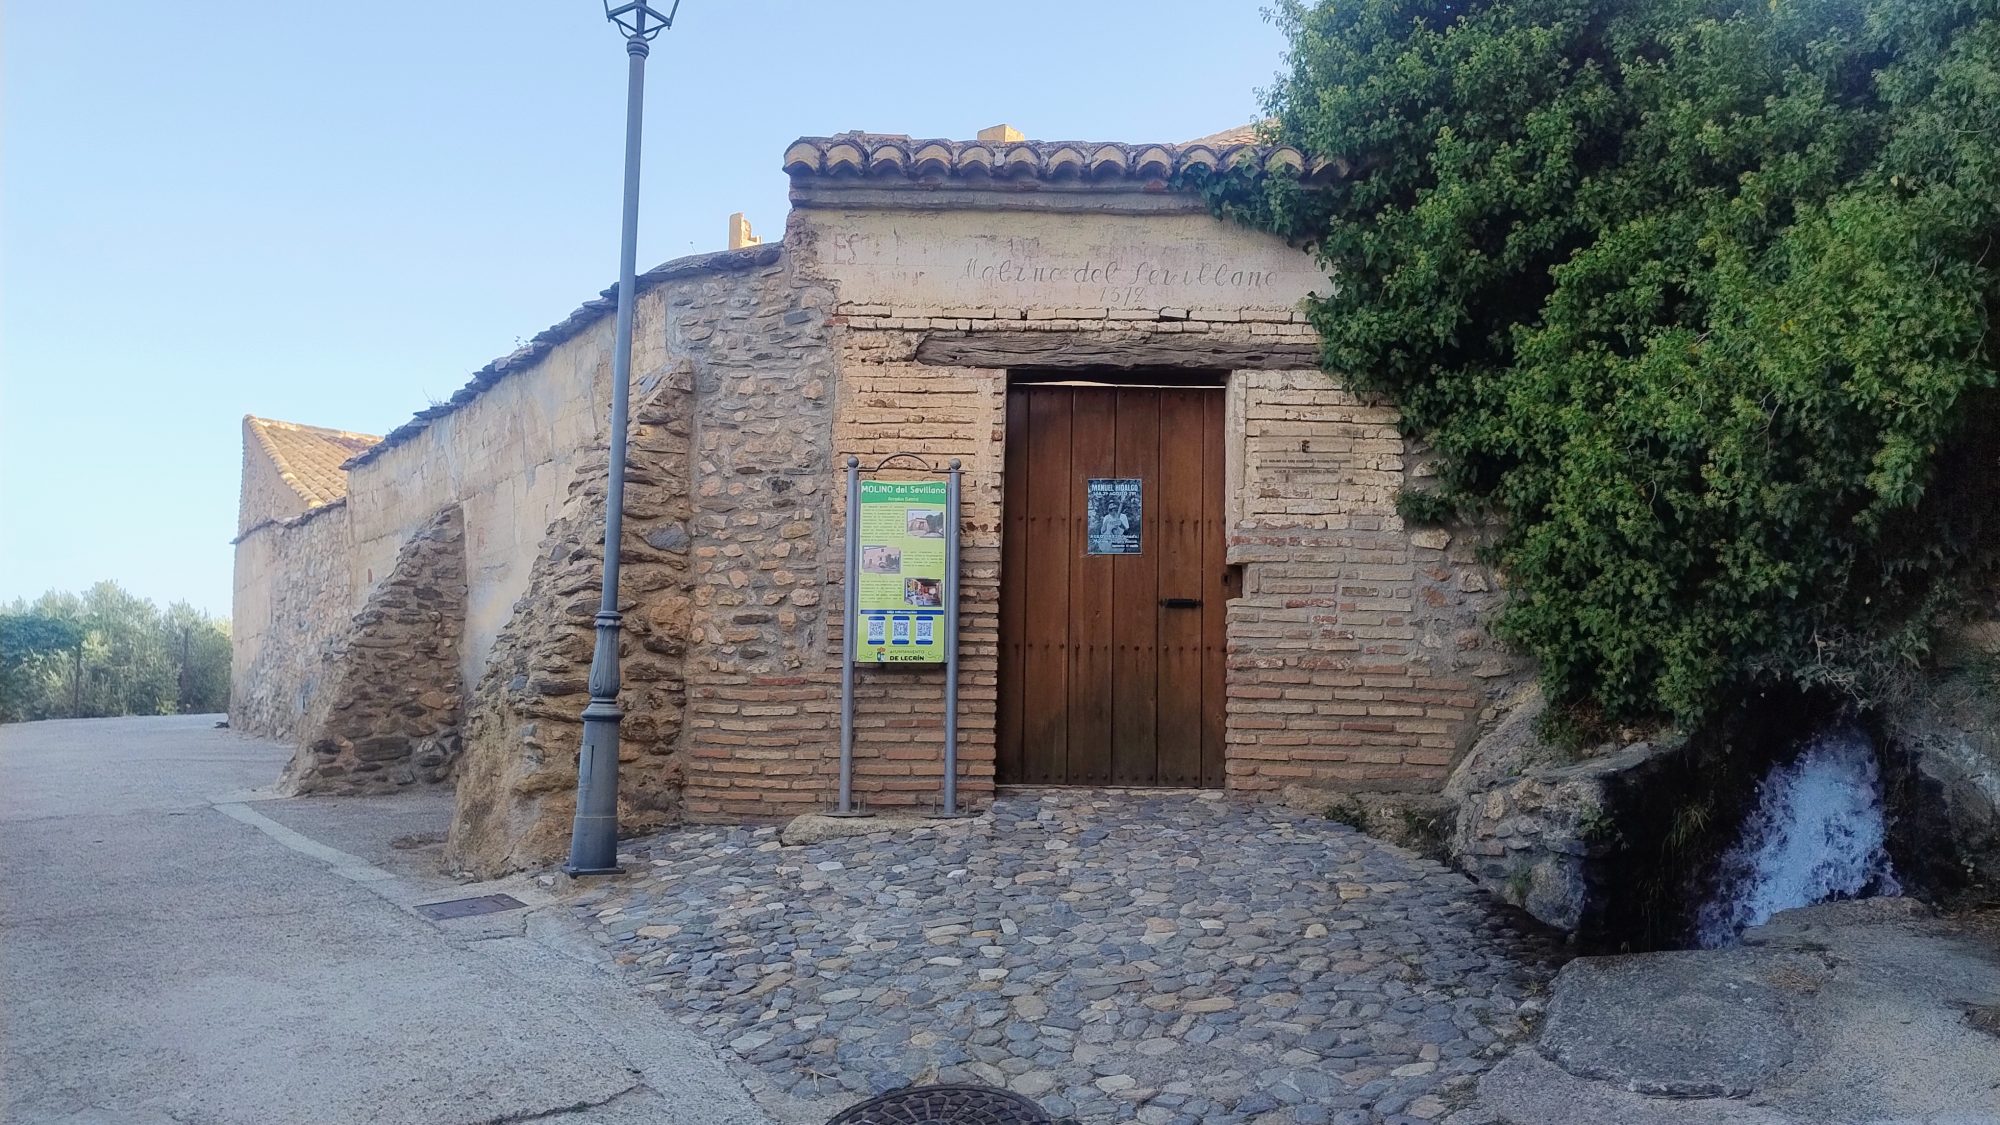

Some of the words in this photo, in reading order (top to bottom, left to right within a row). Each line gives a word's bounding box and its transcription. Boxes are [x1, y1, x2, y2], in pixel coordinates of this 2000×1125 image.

[1074, 261, 1119, 284] del
[1130, 261, 1278, 287] Sevillano
[861, 485, 893, 493] MOLINO
[895, 485, 907, 494] del
[910, 485, 946, 495] Sevillano
